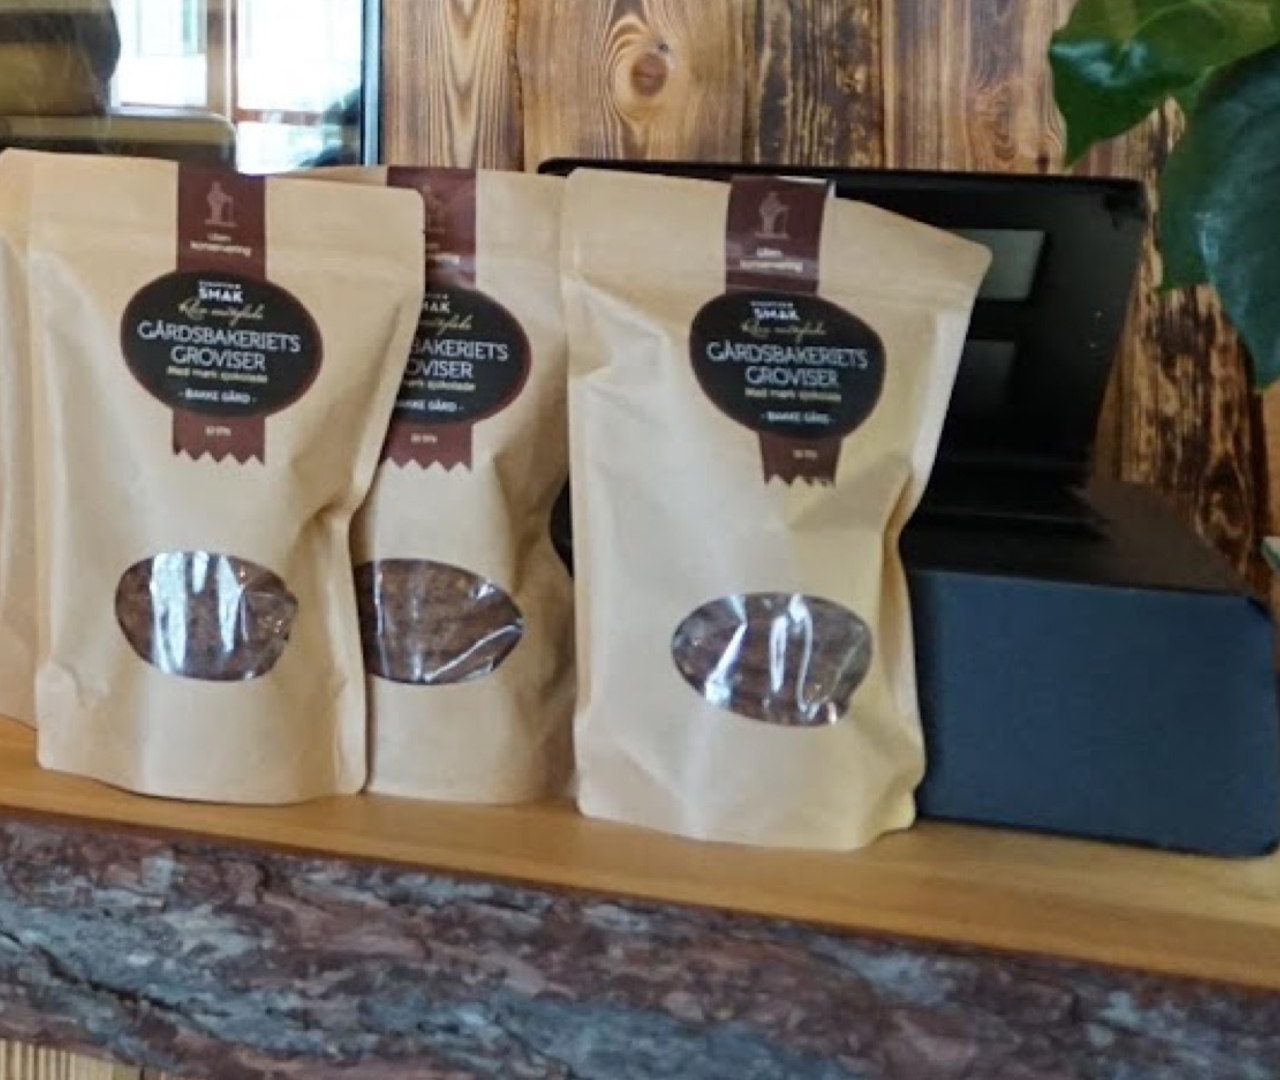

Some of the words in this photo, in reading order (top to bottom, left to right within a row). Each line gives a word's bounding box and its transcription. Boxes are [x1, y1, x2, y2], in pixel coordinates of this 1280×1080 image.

[198, 288, 244, 303] SMAK
[137, 320, 302, 353] GÅRDSBAKERIETS
[170, 345, 266, 371] GROVISER
[410, 338, 510, 363] BAKERIETS
[706, 339, 869, 370] GÅRDSBAKERIETS
[406, 358, 475, 380] OVISER
[744, 366, 840, 388] GROVISER
